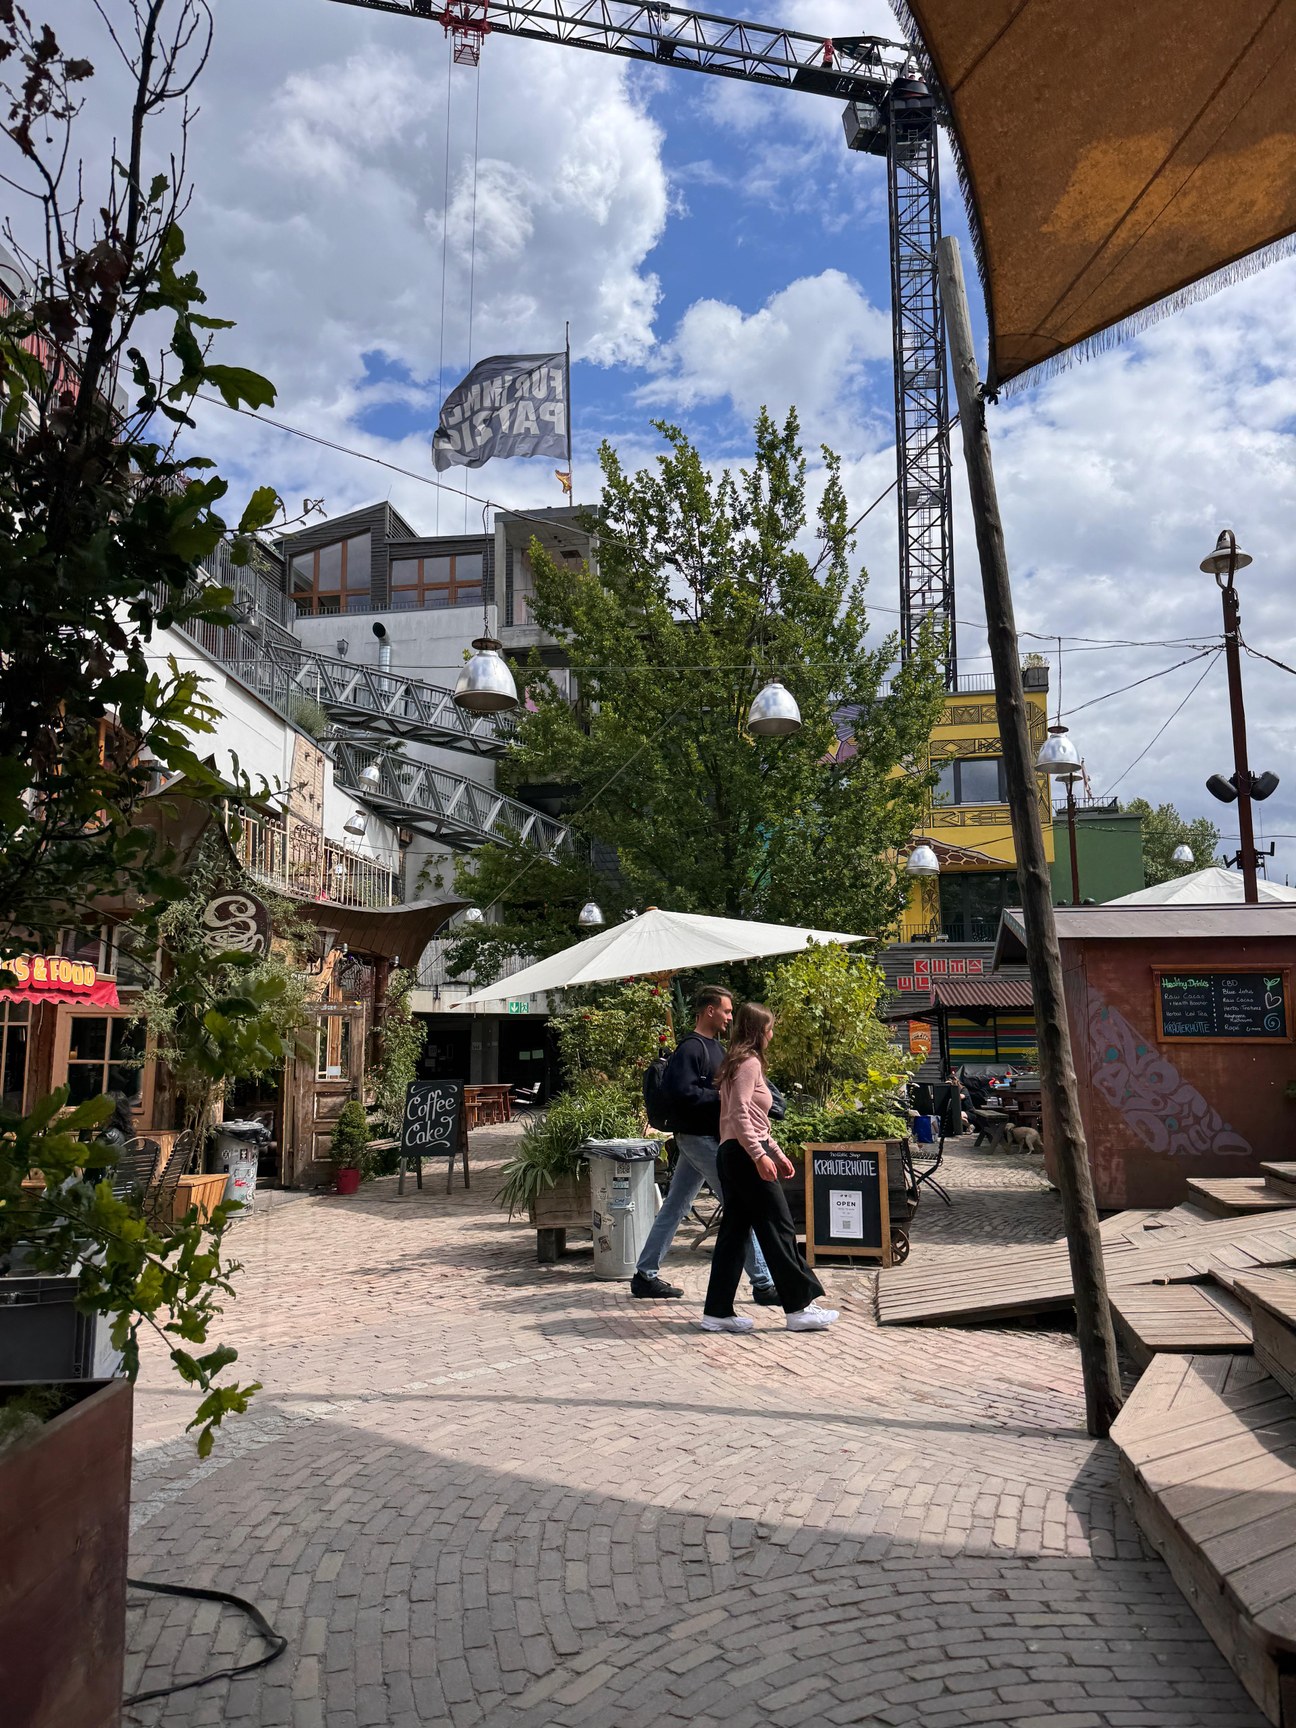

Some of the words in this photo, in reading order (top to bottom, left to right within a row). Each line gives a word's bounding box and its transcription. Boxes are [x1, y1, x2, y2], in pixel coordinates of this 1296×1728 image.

[33, 956, 48, 982] &
[50, 959, 96, 986] FOOD
[406, 1090, 456, 1122] Coffee
[406, 1116, 455, 1146] Cake
[814, 1159, 876, 1176] KRÄUTERHÜTTE
